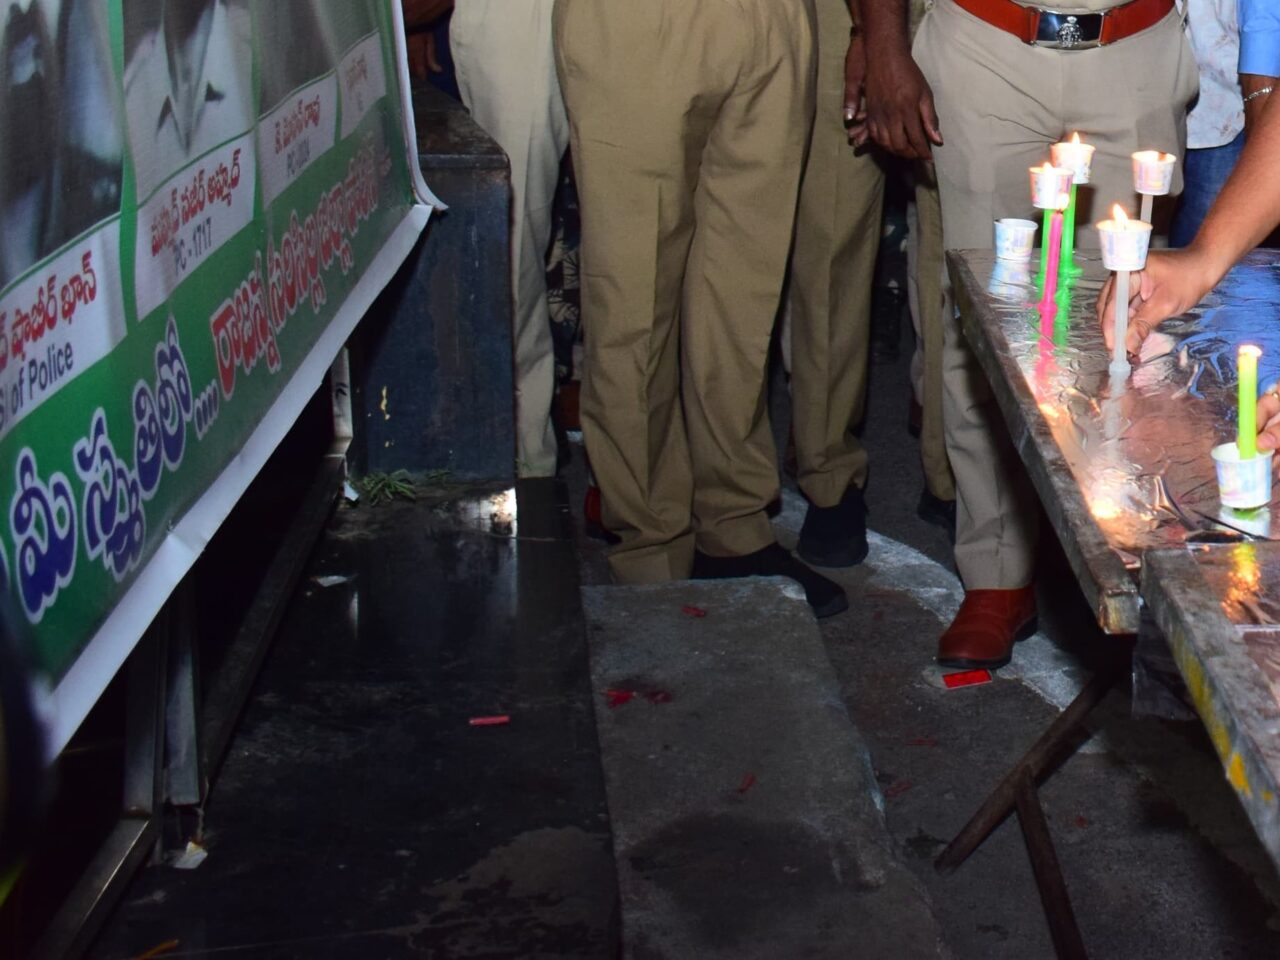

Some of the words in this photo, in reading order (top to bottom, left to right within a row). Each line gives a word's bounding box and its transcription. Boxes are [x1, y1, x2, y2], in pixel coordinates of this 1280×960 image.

[192, 215, 212, 259] 1717
[11, 367, 25, 416] of
[28, 341, 74, 401] Police
